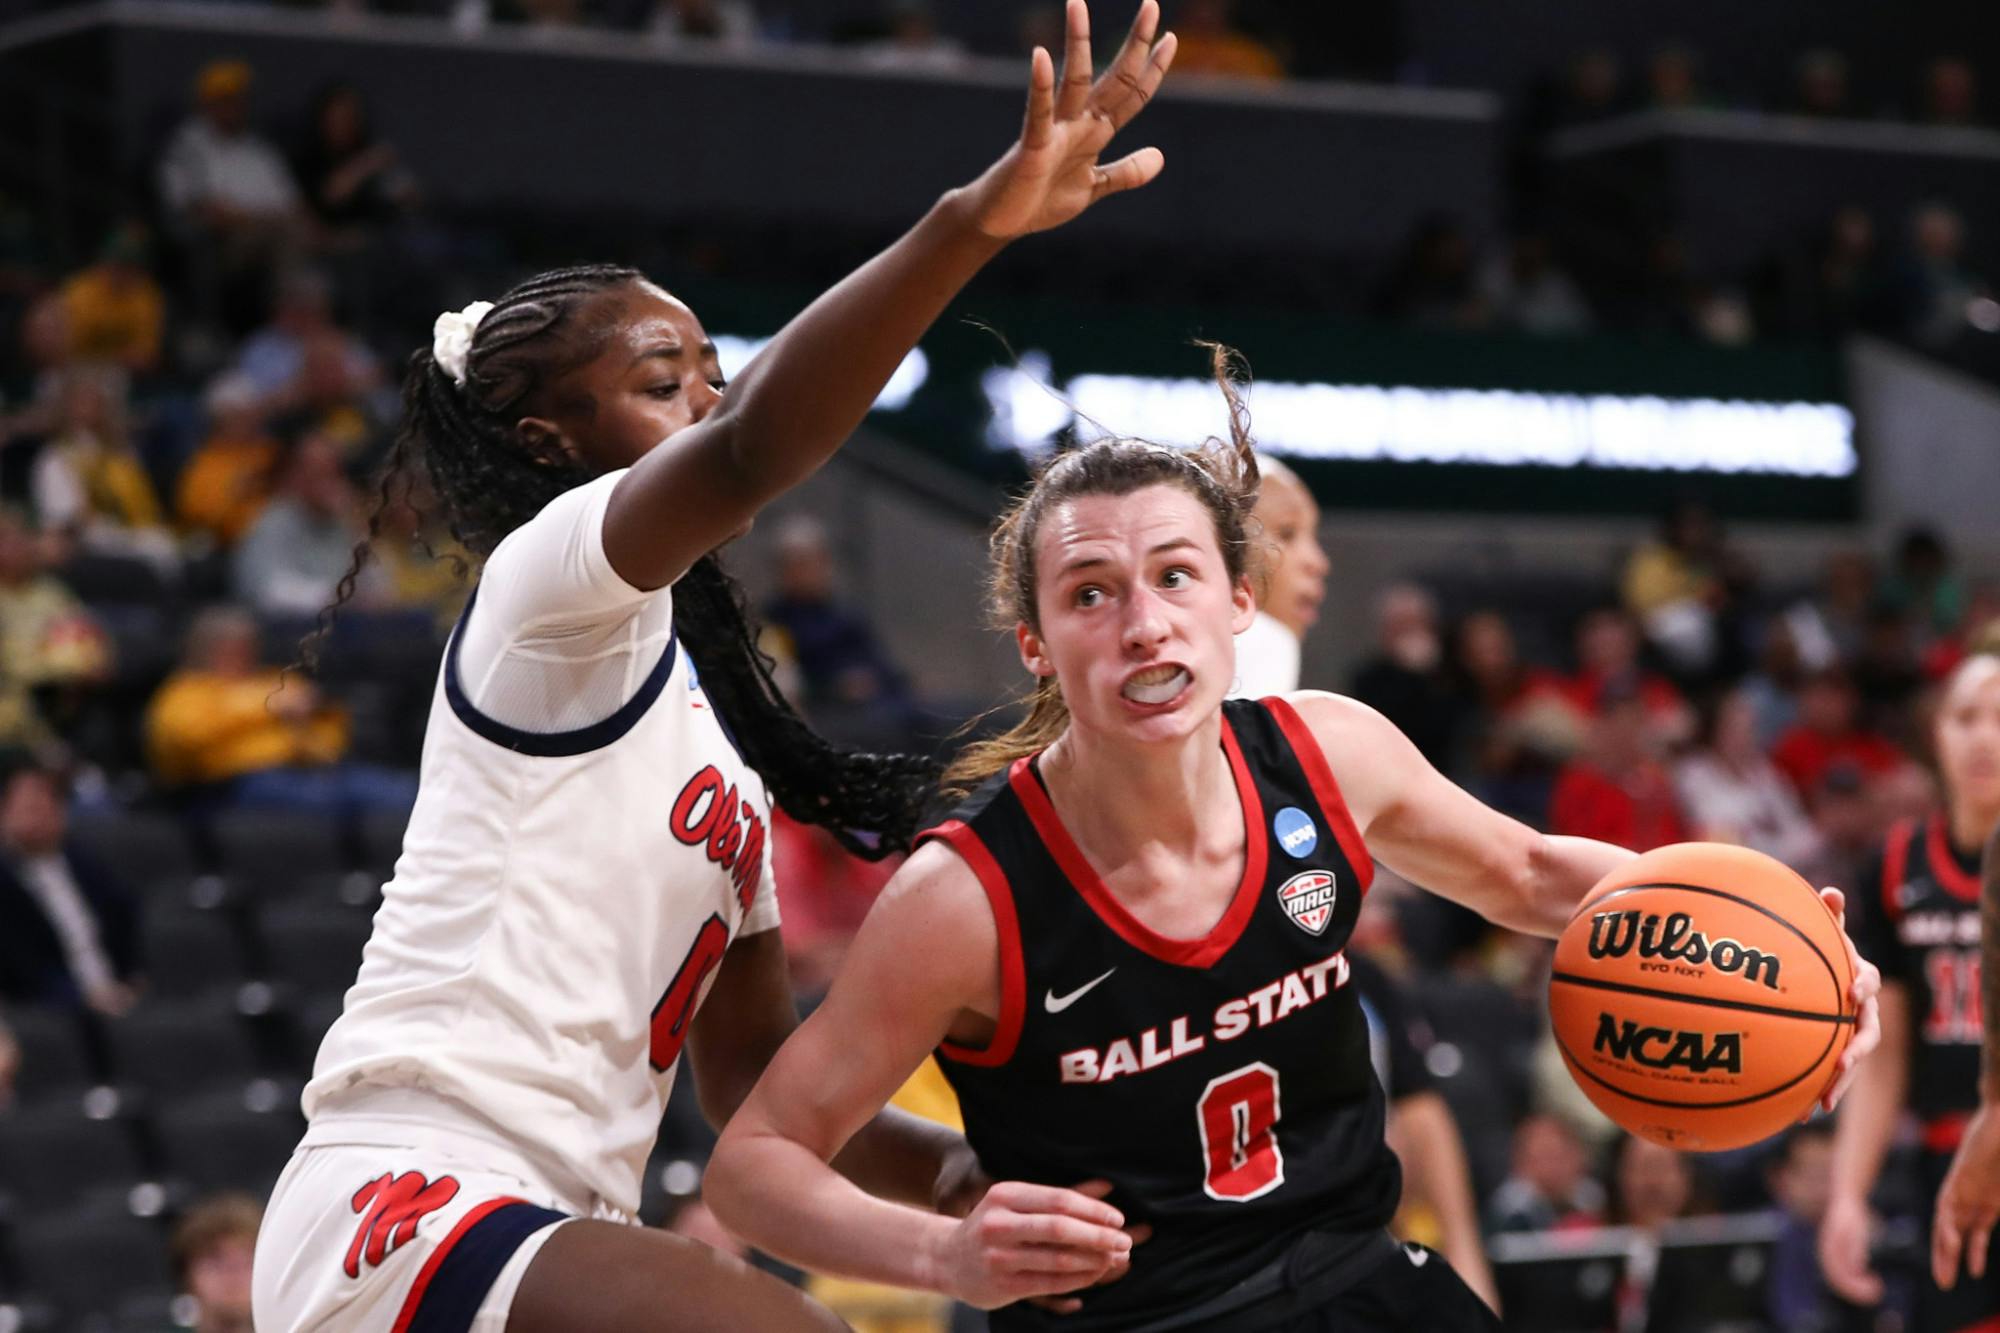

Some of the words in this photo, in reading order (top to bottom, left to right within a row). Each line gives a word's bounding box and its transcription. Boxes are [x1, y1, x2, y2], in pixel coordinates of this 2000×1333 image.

[669, 763, 742, 871] Ole
[1282, 823, 1318, 850] NCAA
[1286, 884, 1334, 916] MAC
[1587, 909, 1781, 991] Wilson
[1639, 961, 1670, 974] EVO
[1674, 965, 1705, 980] NXT
[1060, 1015, 1205, 1085] BALL
[1592, 1012, 1742, 1074] NCAA
[1651, 1070, 1694, 1084] GAME
[1698, 1076, 1741, 1087] BALL
[1197, 1061, 1285, 1202] 0
